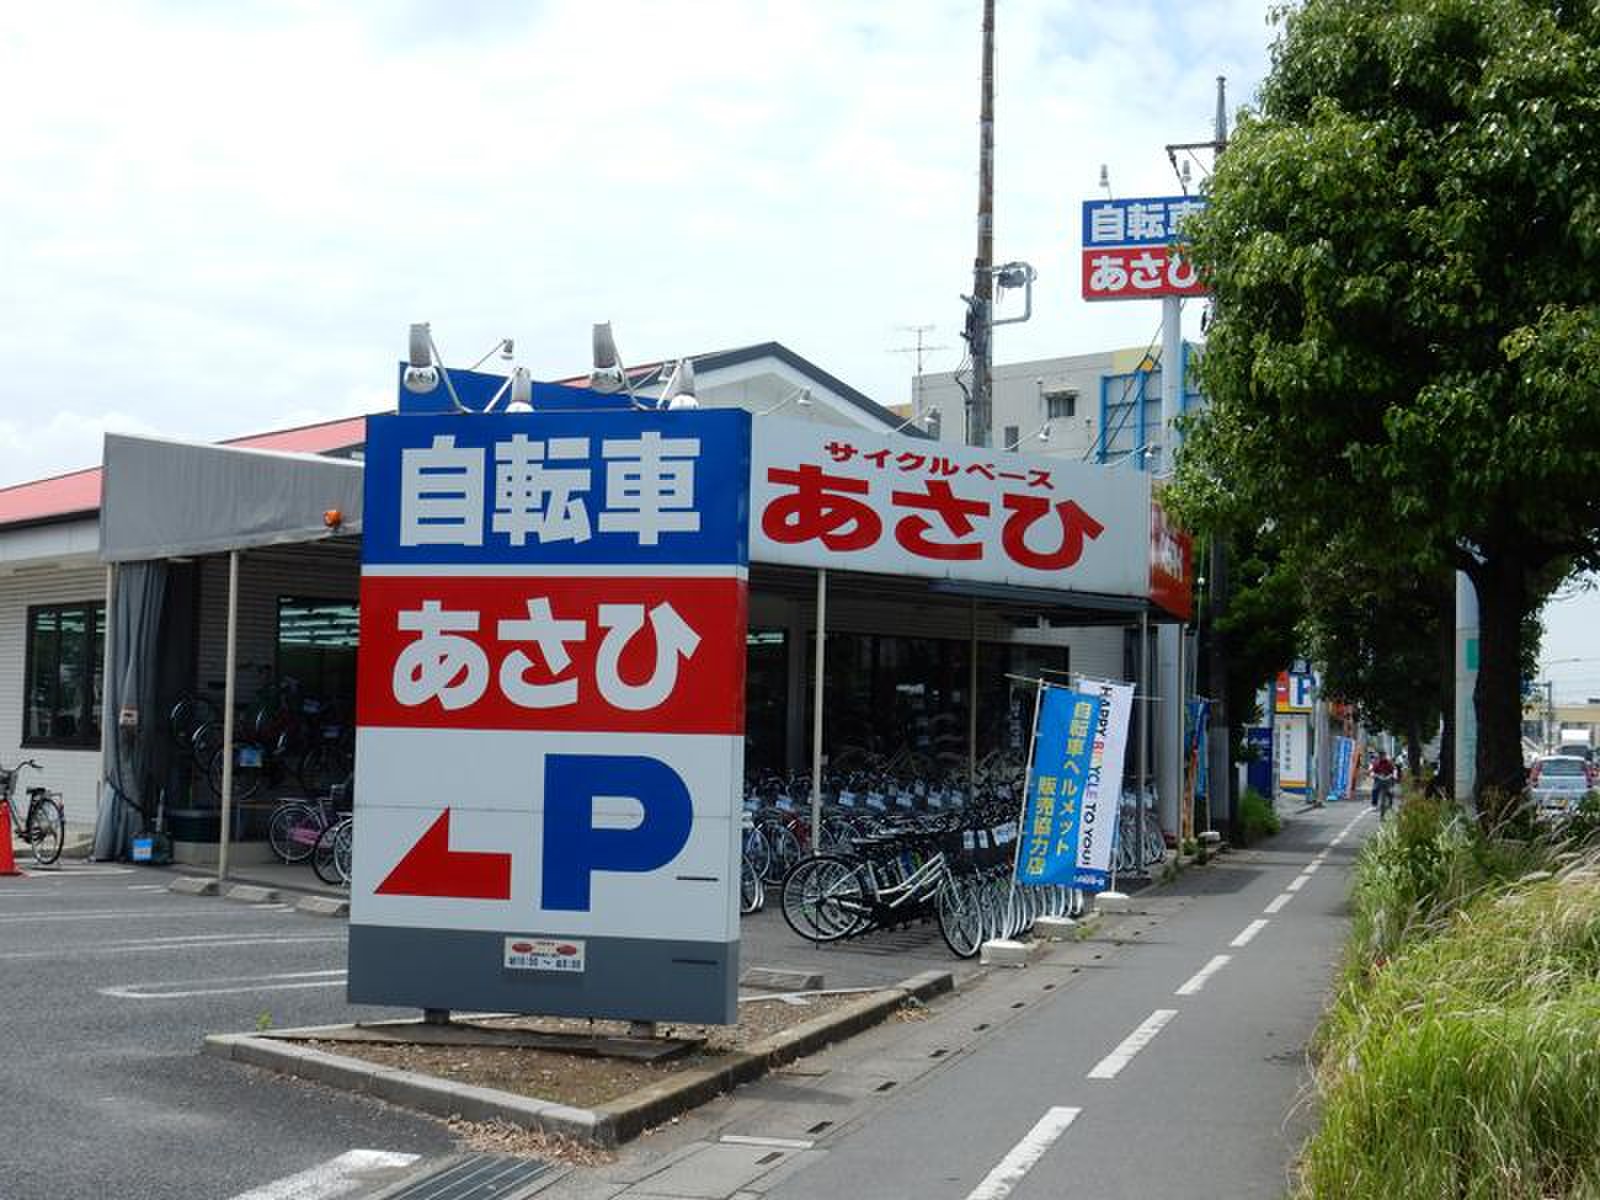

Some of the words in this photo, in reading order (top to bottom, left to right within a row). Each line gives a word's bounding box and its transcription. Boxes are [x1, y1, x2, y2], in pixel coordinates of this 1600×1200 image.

[400, 432, 700, 546] 自転車
[761, 463, 1105, 571] あさひ
[825, 441, 1055, 489] サイクルベース
[392, 597, 702, 711] あさひ
[1098, 686, 1112, 737] HAPPY
[541, 753, 693, 912] P
[1056, 701, 1092, 857] 自転車ヘルメット
[1084, 803, 1097, 824] TO
